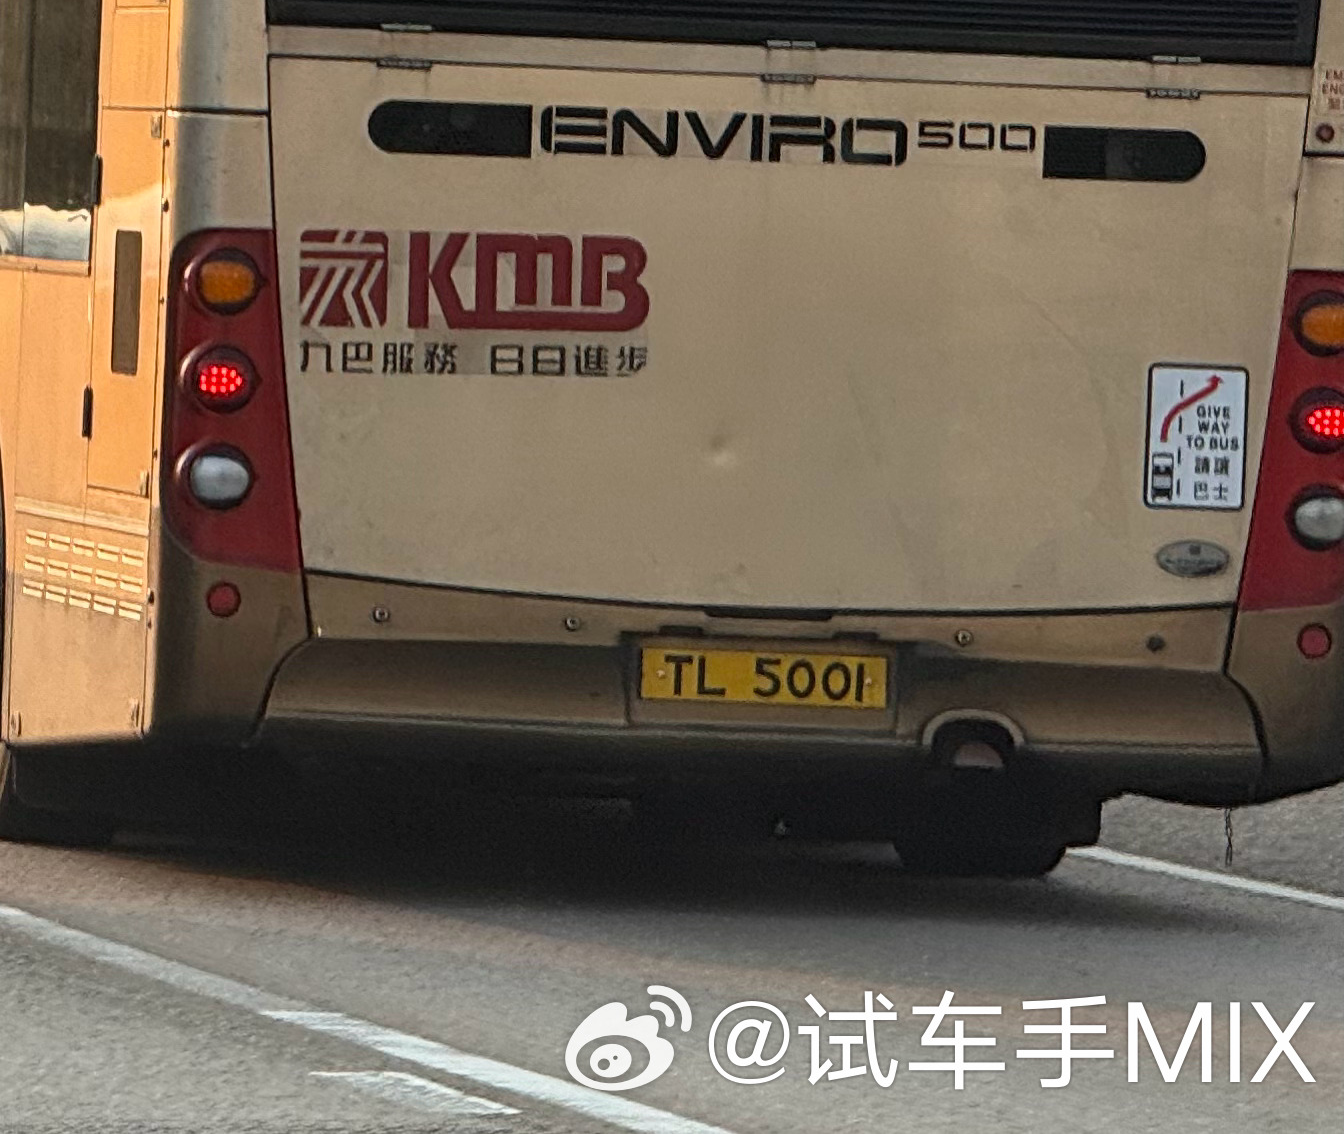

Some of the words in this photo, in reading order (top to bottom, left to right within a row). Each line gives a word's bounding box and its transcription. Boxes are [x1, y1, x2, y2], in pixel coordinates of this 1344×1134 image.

[540, 105, 908, 167] ENVIRO
[917, 120, 1037, 154] 500
[408, 232, 650, 332] KMB
[300, 339, 458, 374] 九巴服務
[490, 344, 648, 378] 日日進步
[1196, 406, 1230, 419] GIVE
[1198, 420, 1230, 435] WAY
[1186, 436, 1205, 450] TO
[1210, 437, 1239, 451] BUS
[664, 657, 726, 699] TL
[754, 659, 867, 703] 5001
